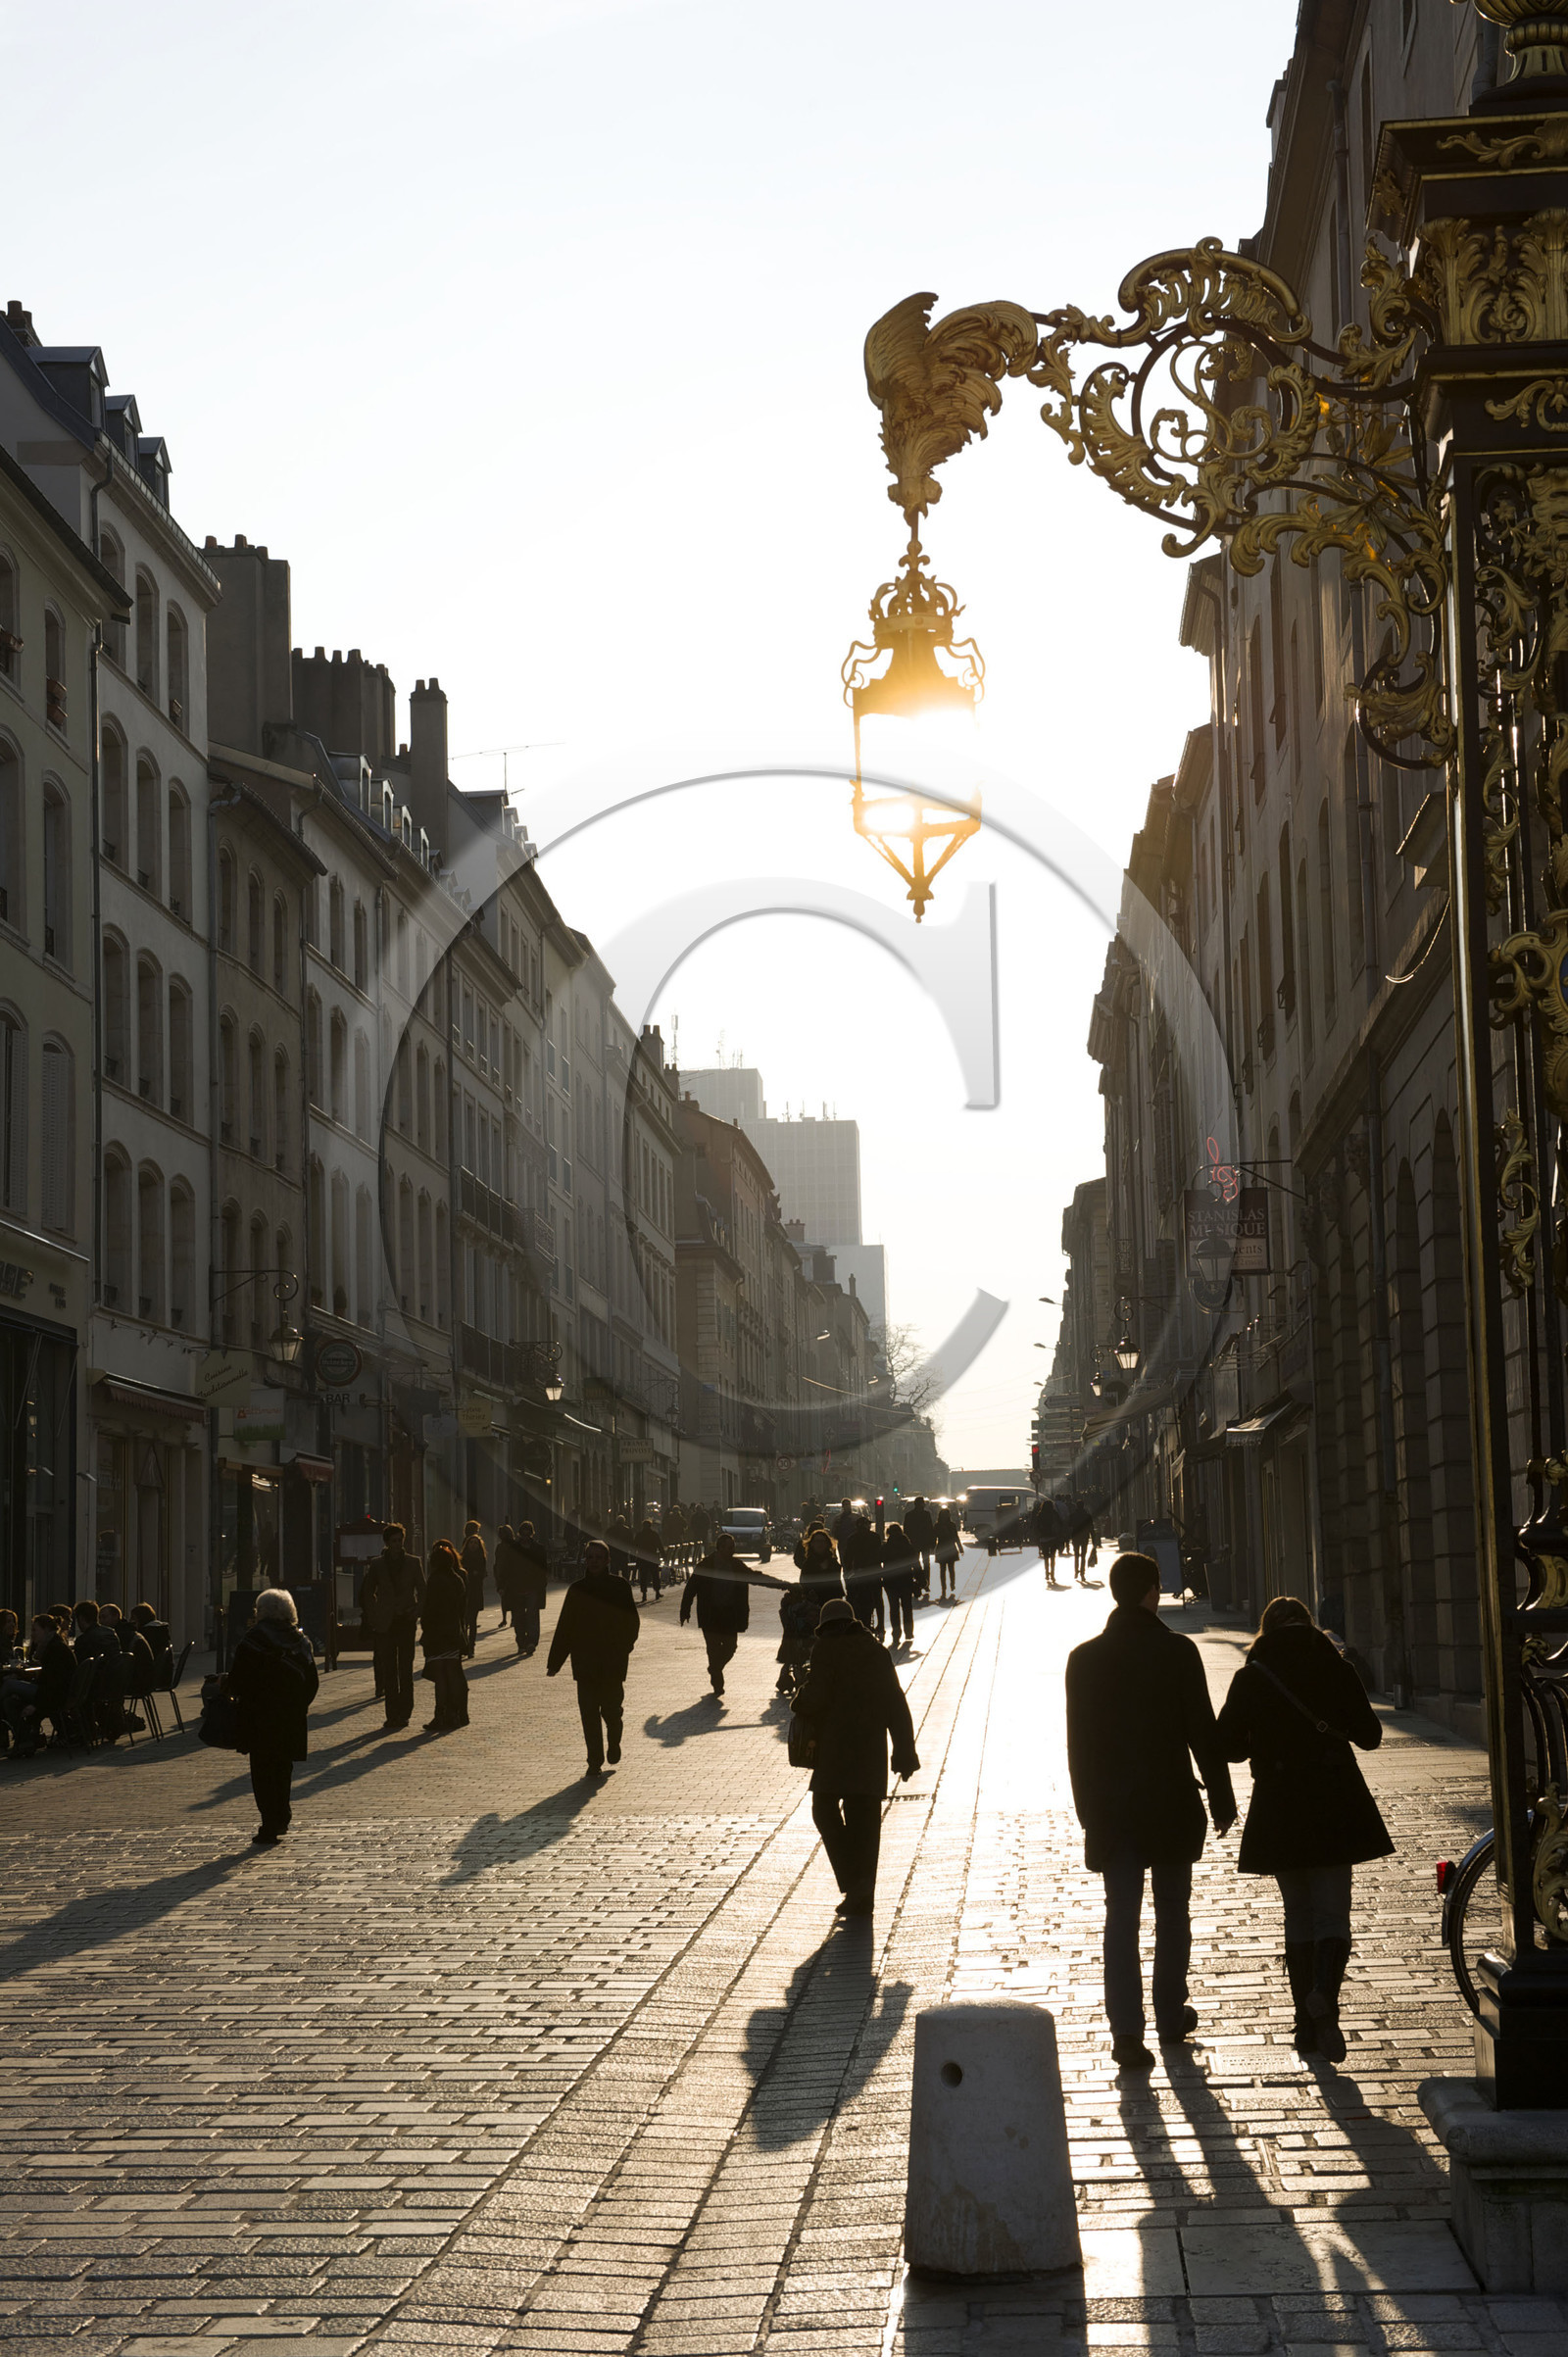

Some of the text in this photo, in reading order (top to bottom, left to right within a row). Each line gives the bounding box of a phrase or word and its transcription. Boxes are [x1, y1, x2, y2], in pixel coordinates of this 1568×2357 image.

[1187, 1207, 1265, 1223] STANISLAS
[204, 1363, 232, 1383] Cuisine
[325, 1393, 351, 1404] BAR
